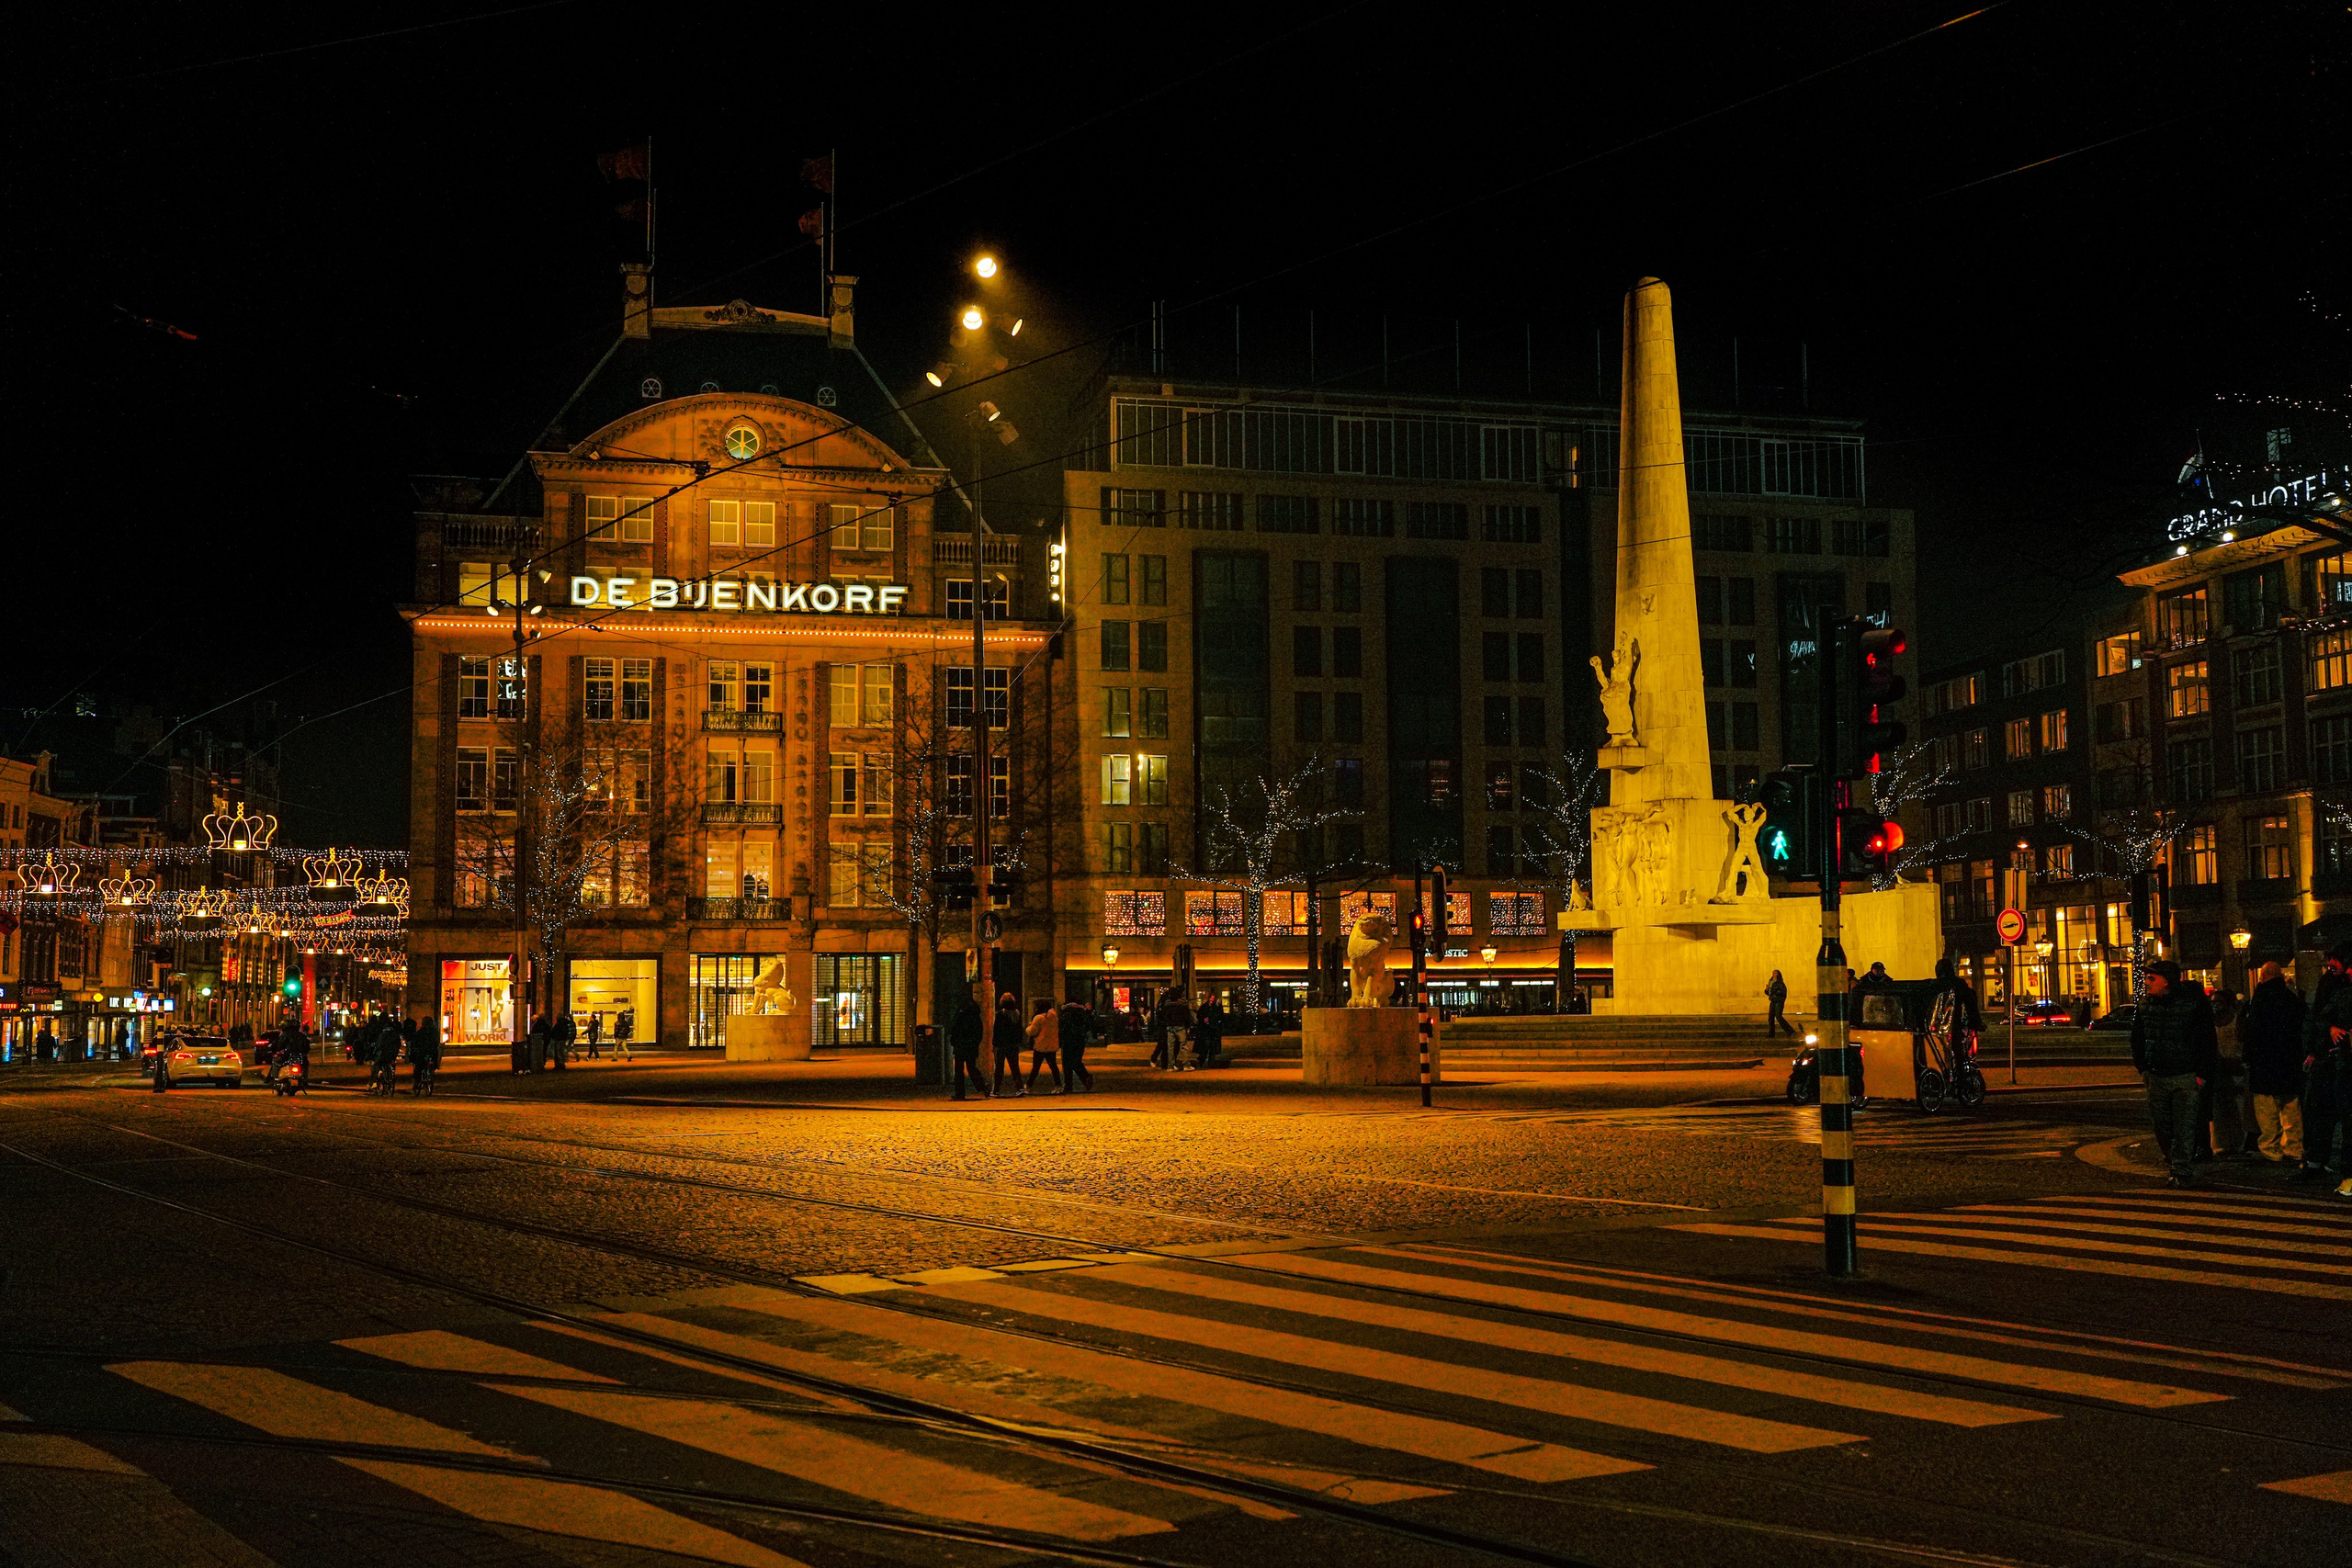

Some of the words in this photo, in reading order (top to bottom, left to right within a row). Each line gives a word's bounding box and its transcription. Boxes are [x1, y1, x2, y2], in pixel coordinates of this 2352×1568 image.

[2166, 500, 2244, 541] GRAND
[2251, 470, 2336, 507] HOTEL
[571, 577, 637, 606] DE
[649, 578, 909, 615] BIJENKORF
[470, 963, 503, 971] JUST
